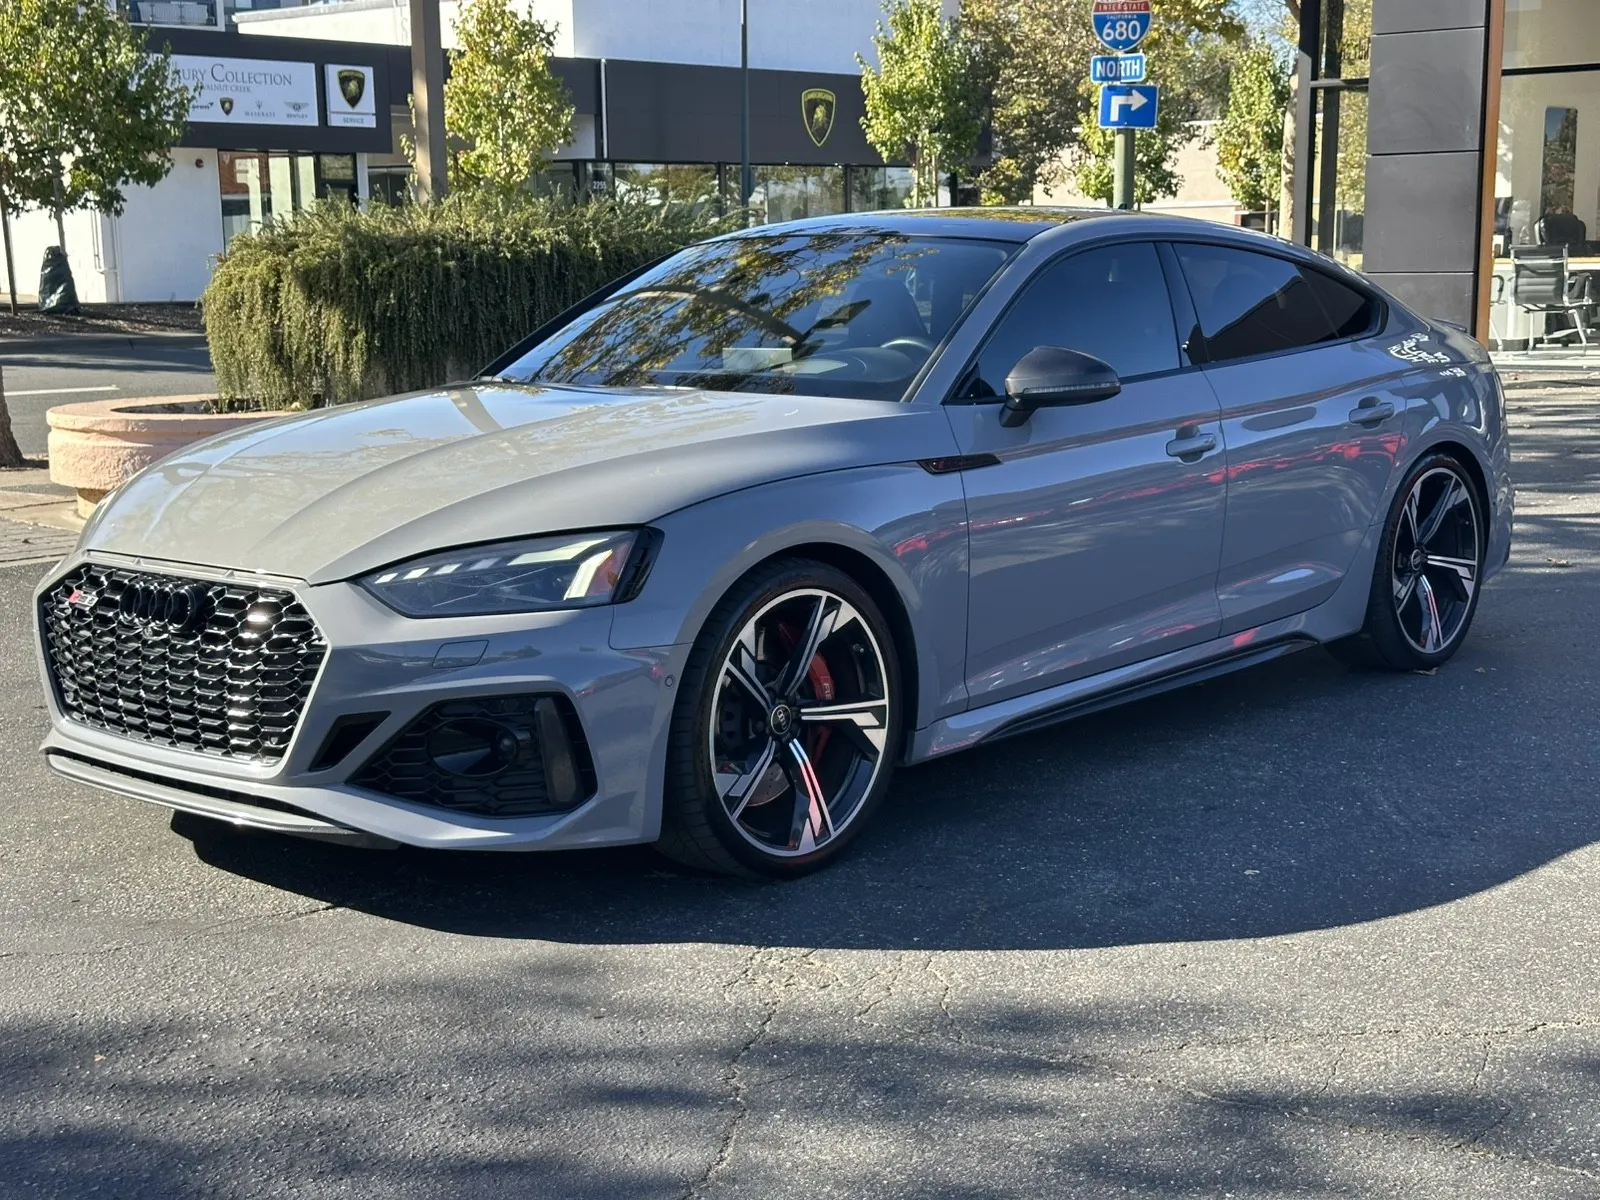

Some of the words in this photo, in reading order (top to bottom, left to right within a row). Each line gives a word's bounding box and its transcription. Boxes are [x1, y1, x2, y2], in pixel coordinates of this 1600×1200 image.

[1098, 3, 1146, 11] INTERSTATE
[1102, 20, 1141, 41] 680
[210, 63, 292, 86] COLLECTION
[1096, 59, 1141, 78] NORTH
[230, 85, 252, 93] CREEK
